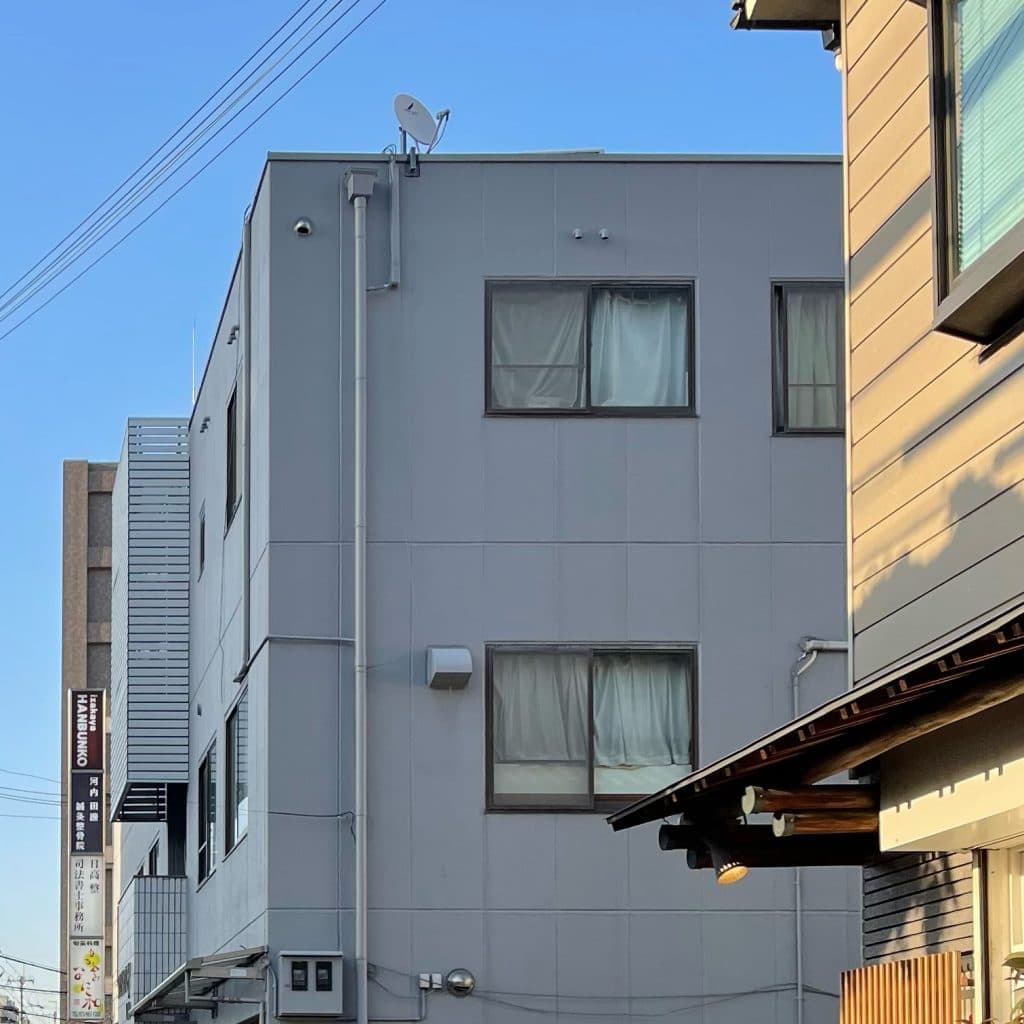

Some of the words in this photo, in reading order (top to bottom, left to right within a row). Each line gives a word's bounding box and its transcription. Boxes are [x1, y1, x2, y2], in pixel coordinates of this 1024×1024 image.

[76, 694, 88, 767] HANBUNKO
[74, 859, 85, 933] 司法書士事務所
